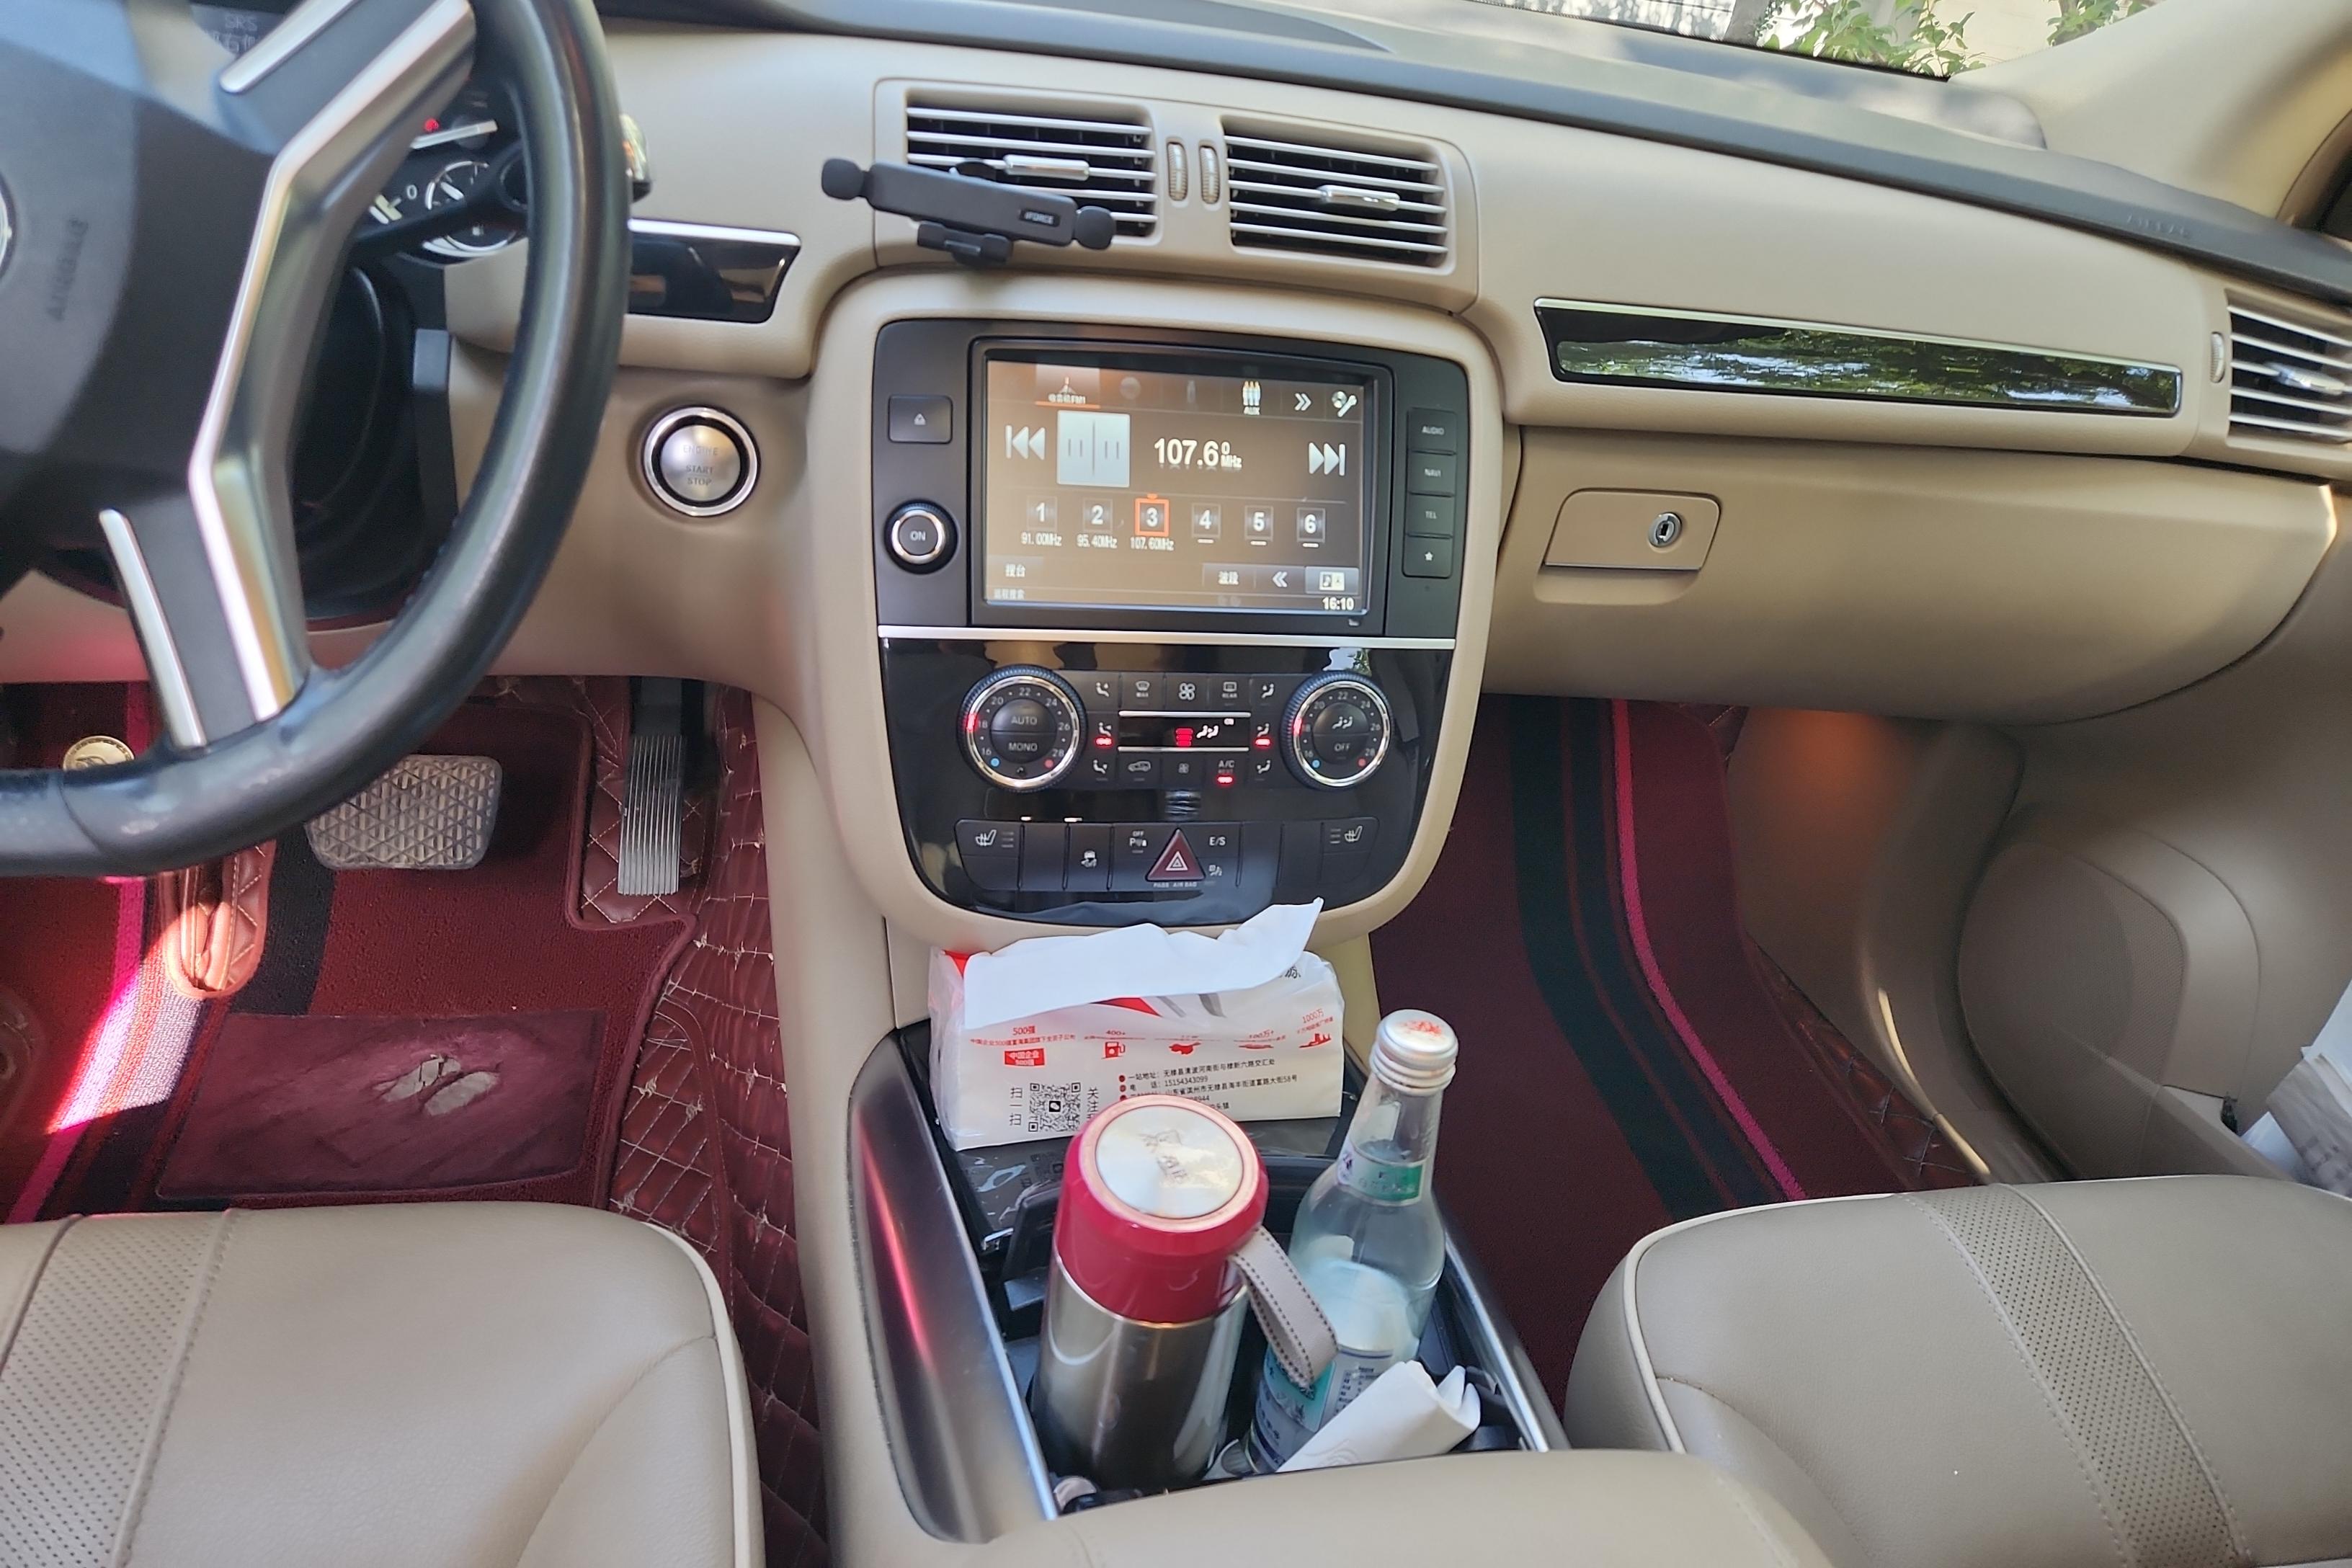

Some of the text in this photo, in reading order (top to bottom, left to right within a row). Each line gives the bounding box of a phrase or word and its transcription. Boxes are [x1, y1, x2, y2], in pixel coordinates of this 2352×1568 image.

[1422, 426, 1445, 435] AUDIO
[683, 444, 718, 455] ENGINE
[1154, 438, 1219, 467] 107.6
[1221, 455, 1242, 468] MHz
[686, 464, 714, 474] START
[1424, 468, 1442, 477] NAVI
[687, 476, 713, 486] STOP
[1035, 502, 1046, 522] 1
[1091, 504, 1104, 525] 2
[1146, 507, 1159, 527] 3
[1425, 511, 1438, 520] TEL
[1198, 509, 1212, 530] 4
[1252, 511, 1265, 532] 5
[1304, 514, 1317, 534] 6
[909, 530, 927, 542] ON
[1322, 597, 1355, 611] 16:10
[1018, 687, 1032, 697] 22
[1337, 691, 1349, 700] 22
[990, 696, 1004, 705] 20
[1045, 698, 1059, 708] 24
[1313, 700, 1326, 710] 20
[1010, 716, 1038, 726] AUTO
[1058, 722, 1072, 731] 26
[981, 747, 992, 757] 16
[1008, 742, 1038, 752] MONO
[1334, 742, 1351, 752] OFF
[1051, 748, 1065, 758] 28
[1218, 760, 1235, 769] A/C
[1208, 837, 1226, 847] E/S
[1012, 1025, 1035, 1035] 500强
